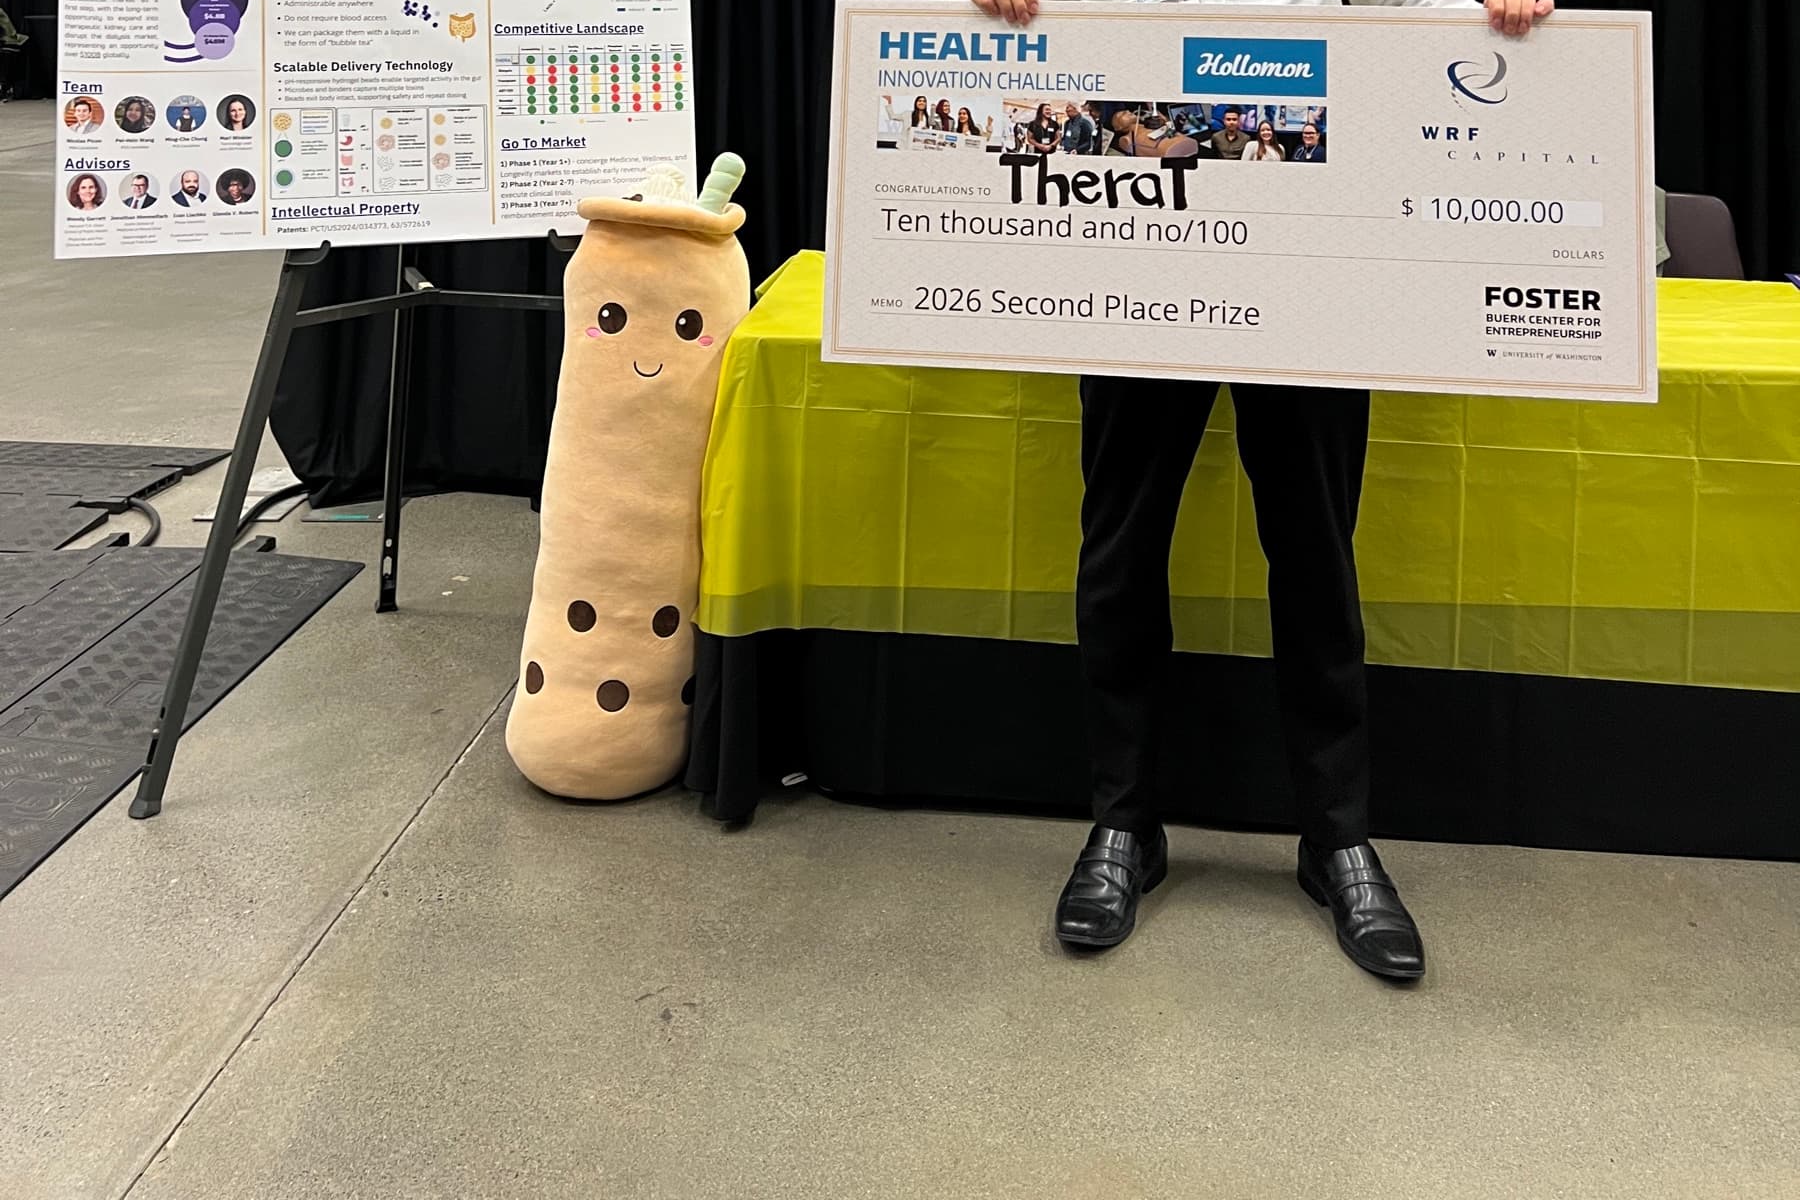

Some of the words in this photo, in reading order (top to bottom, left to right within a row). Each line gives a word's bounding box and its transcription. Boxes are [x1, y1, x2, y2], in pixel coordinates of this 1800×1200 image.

[495, 22, 573, 35] Competitive
[577, 23, 644, 34] Landscape
[879, 32, 1047, 62] HEALTH
[274, 62, 327, 72] Scalable
[331, 61, 381, 73] Delivery
[385, 61, 453, 72] Technology
[1196, 53, 1314, 79] Hollomon
[63, 81, 102, 92] Team
[878, 69, 992, 89] INNOVATION
[997, 72, 1106, 92] CHALLENGE
[1422, 126, 1479, 141] WRF
[501, 139, 518, 149] Go
[523, 138, 537, 148] To
[542, 137, 586, 147] Market
[65, 158, 130, 169] Advisors
[576, 157, 608, 165] concierge
[1448, 151, 1598, 164] CAPITAL
[540, 179, 557, 187] (Year
[1000, 153, 1198, 210] TheraT
[875, 183, 975, 196] CONGRATULATIONS
[978, 187, 991, 196] TO
[272, 204, 355, 218] Intellectual
[360, 202, 420, 216] Property
[540, 200, 558, 208] (Year
[1402, 197, 1413, 217] $
[1431, 198, 1564, 224] 10,000.00
[882, 208, 930, 233] Ten
[940, 209, 1072, 238] thousand
[1083, 215, 1134, 240] and
[1146, 219, 1248, 245] no/100
[1552, 249, 1605, 260] DOLLARS
[1485, 286, 1601, 311] FOSTER
[871, 298, 903, 308] MEMO
[914, 286, 981, 312] 2026
[991, 289, 1094, 318] Second
[1104, 294, 1178, 322] Place
[1190, 299, 1260, 326] Prize
[1486, 313, 1526, 324] BUERK
[1529, 314, 1574, 326] CENTER
[1578, 316, 1601, 327] FOR
[1486, 326, 1602, 340] ENTREPRENEURSHIP
[1487, 349, 1496, 357] W
[1503, 351, 1544, 359] UNIVERSITY
[1556, 353, 1602, 361] WASHINGTON
